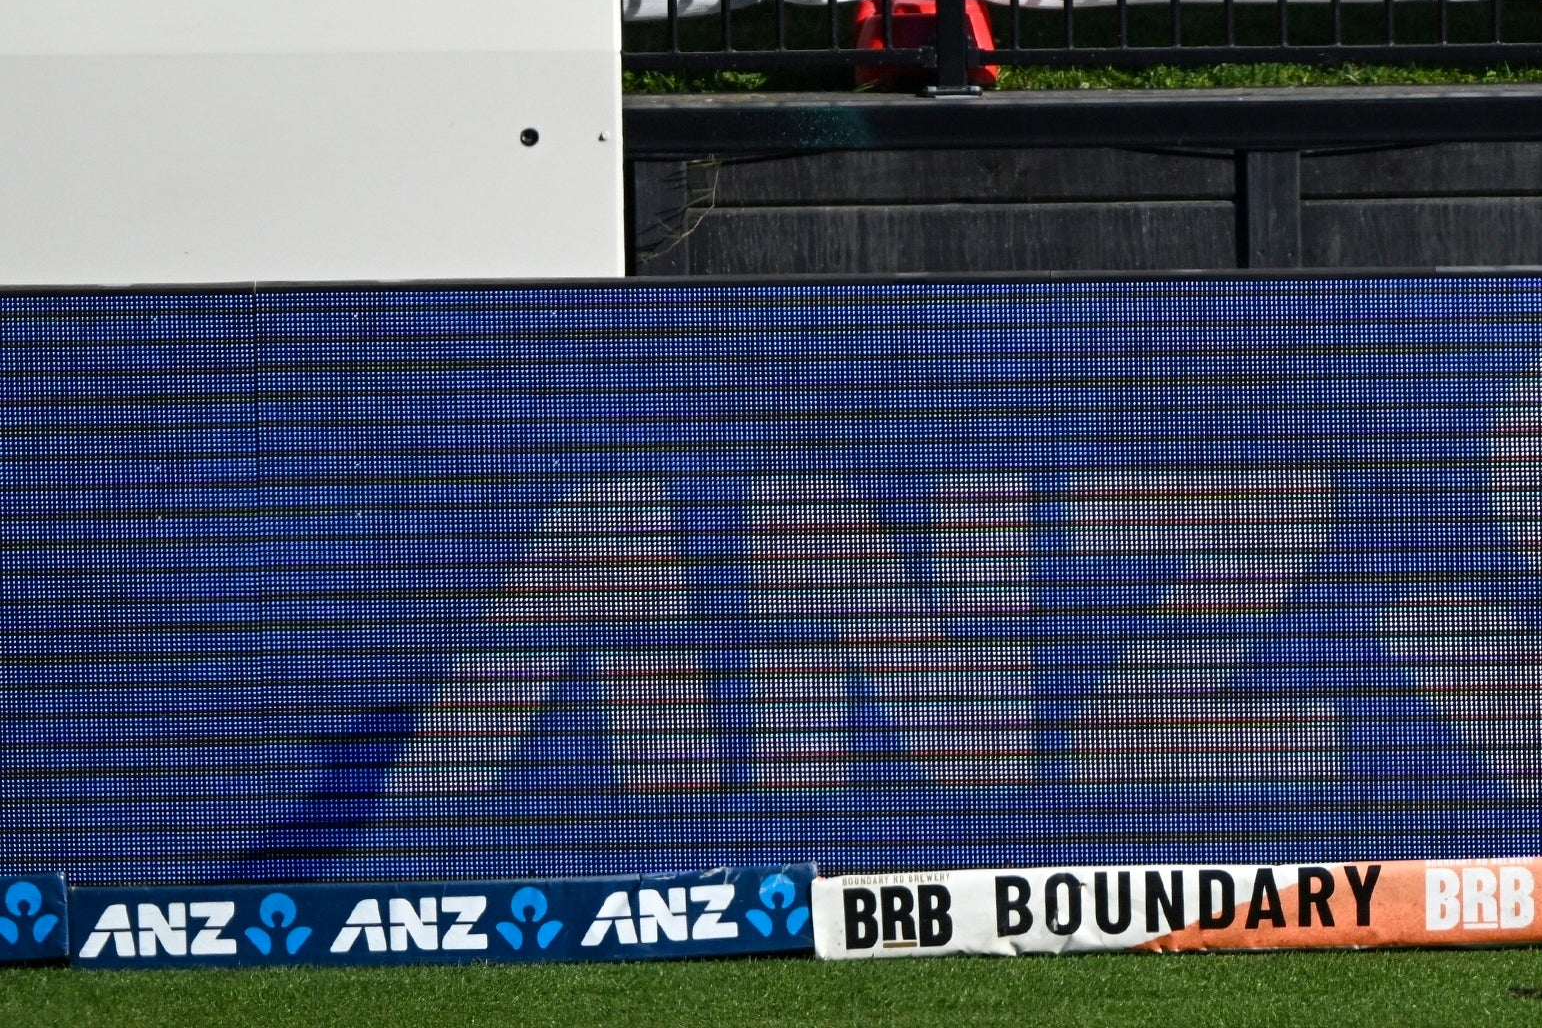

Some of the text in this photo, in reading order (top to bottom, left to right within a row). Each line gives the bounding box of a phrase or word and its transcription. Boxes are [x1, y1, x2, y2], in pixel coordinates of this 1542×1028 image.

[392, 468, 1345, 795] ANZ
[842, 876, 888, 886] BOUNDARY
[908, 873, 950, 883] BREWERY
[995, 864, 1381, 938] BOUNDARY
[1426, 866, 1534, 931] BRB
[79, 901, 237, 957] ANZ
[330, 896, 488, 952] ANZ
[581, 884, 738, 946] ANZ
[843, 884, 953, 950] BRB
